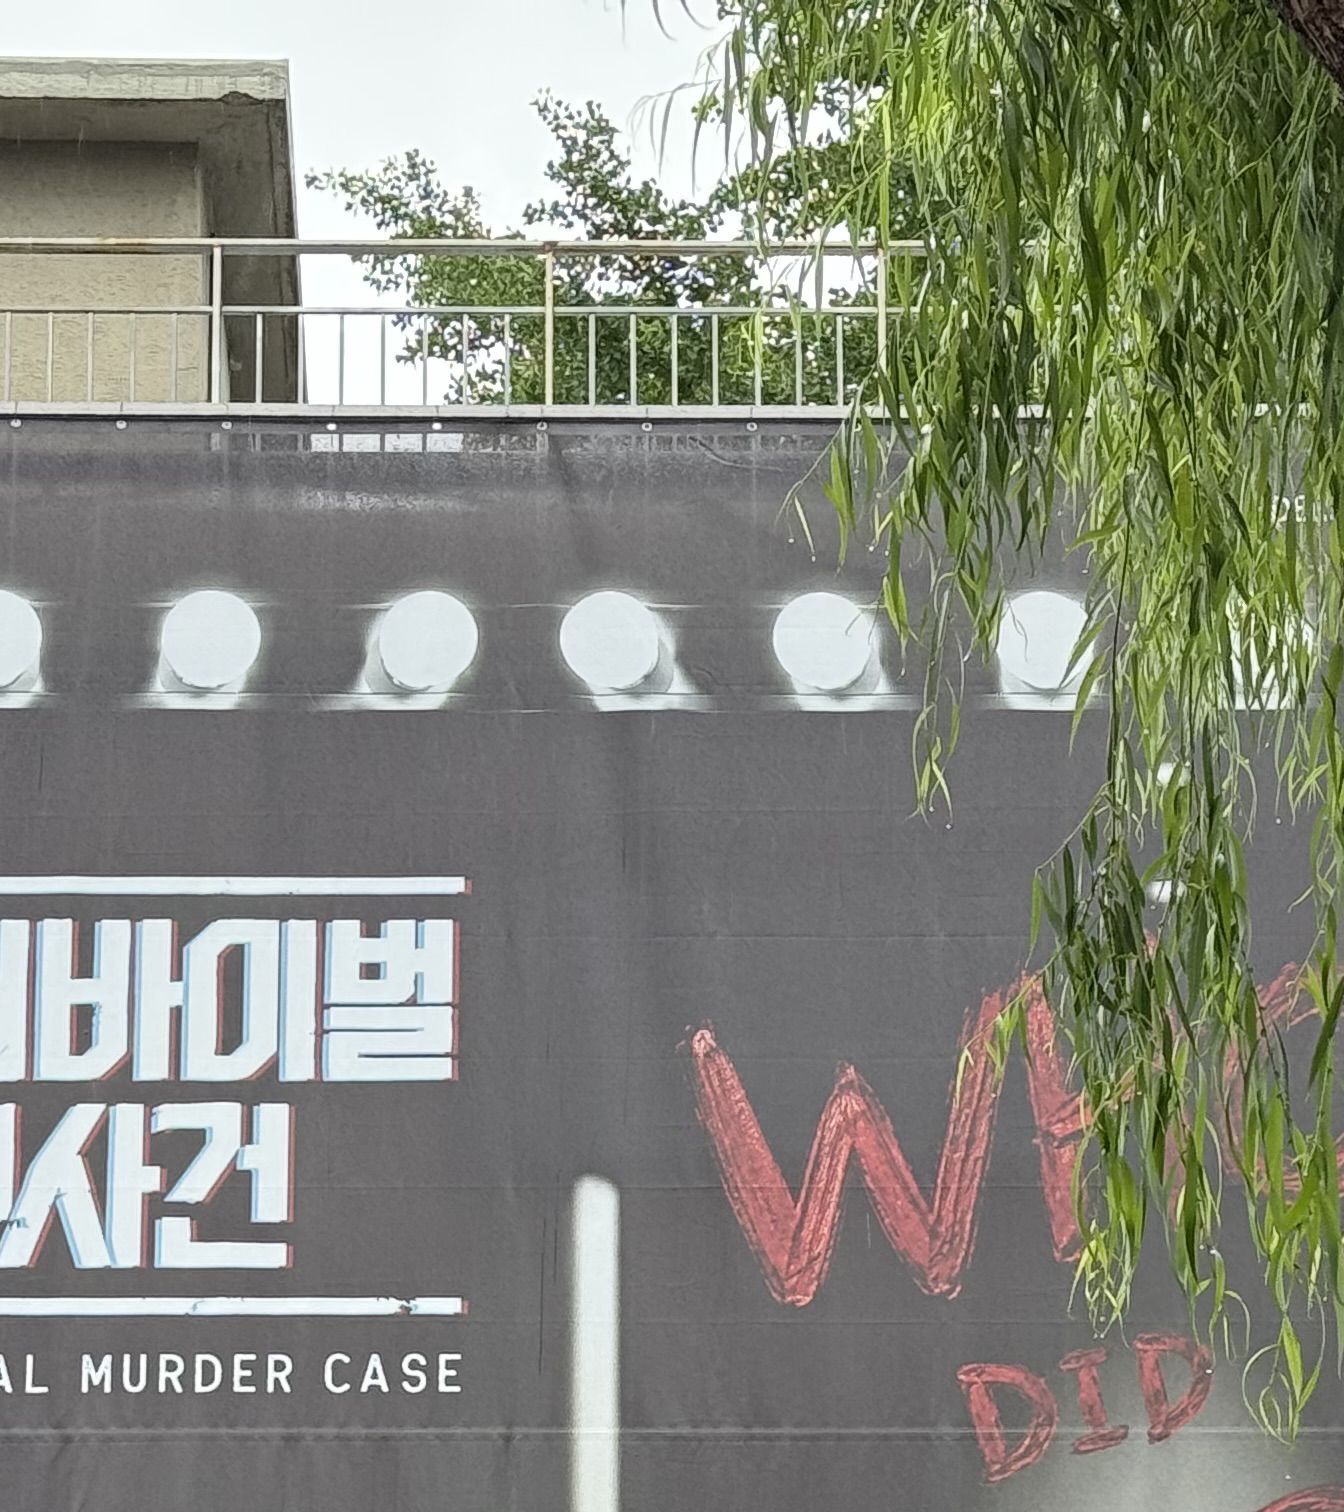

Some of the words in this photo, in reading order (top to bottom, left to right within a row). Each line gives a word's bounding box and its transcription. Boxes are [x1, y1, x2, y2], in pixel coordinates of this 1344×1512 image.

[81, 1352, 294, 1395] MURDER
[322, 1353, 465, 1395] CASE
[956, 1333, 1215, 1484] DID
